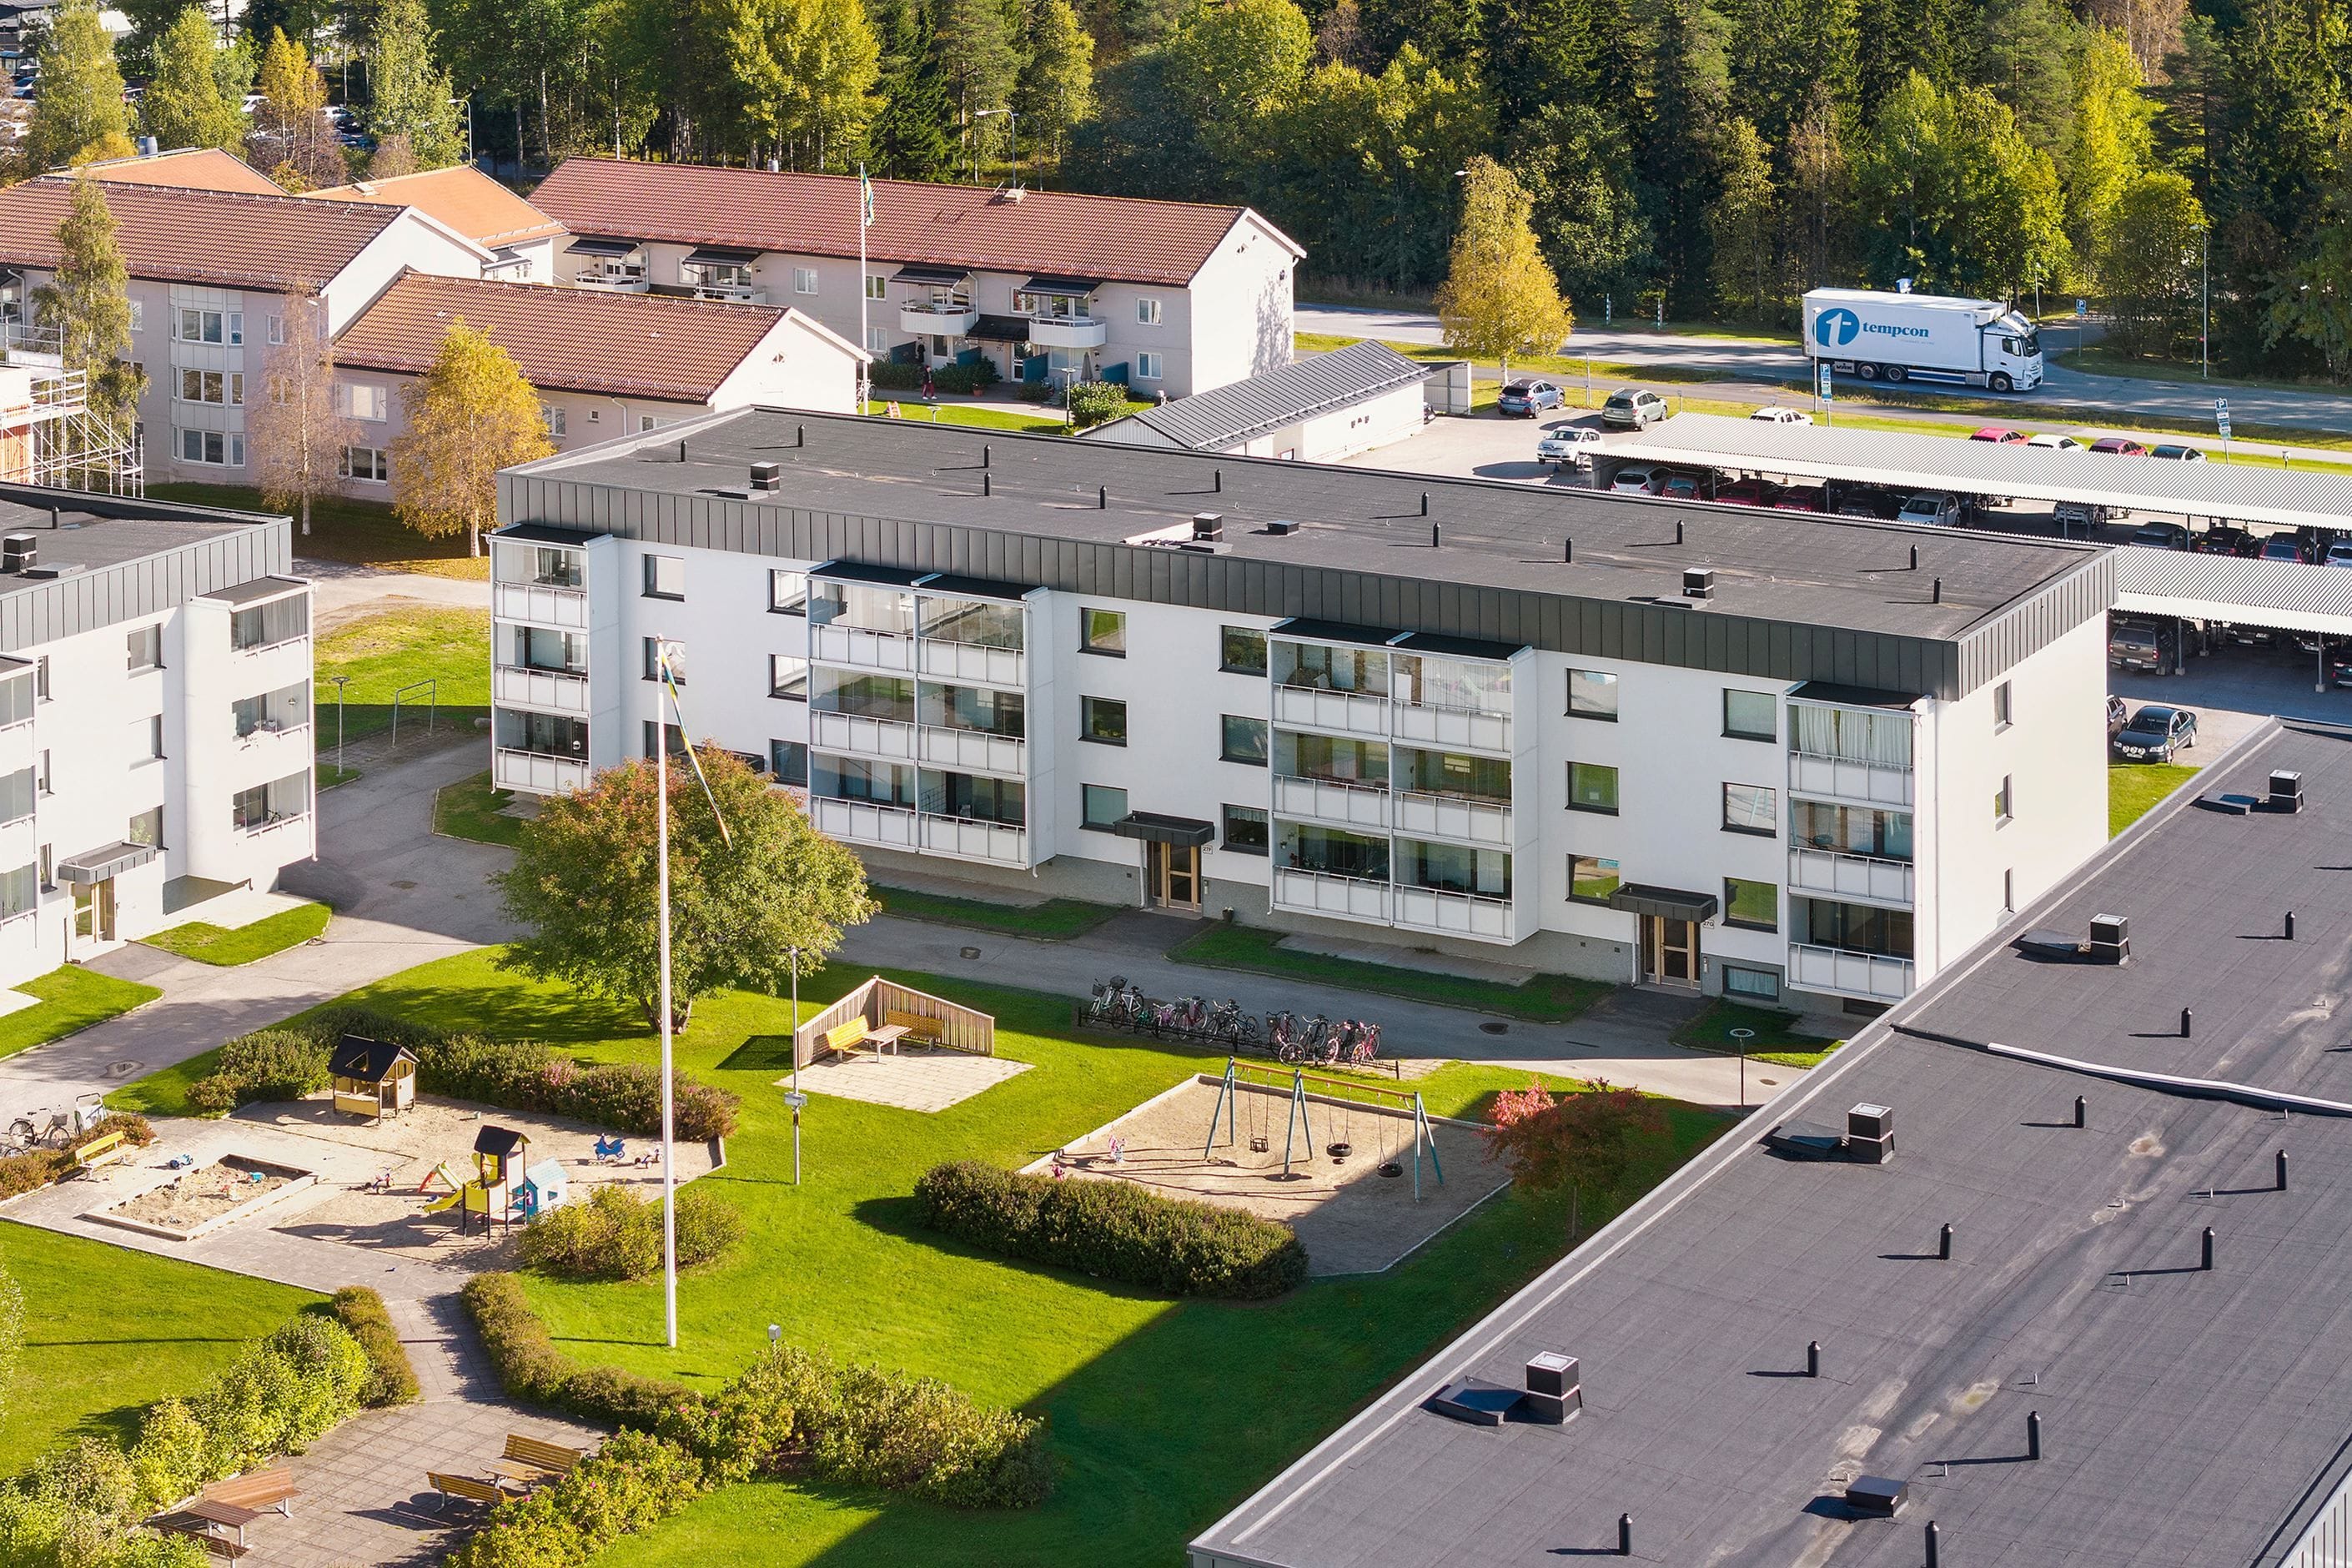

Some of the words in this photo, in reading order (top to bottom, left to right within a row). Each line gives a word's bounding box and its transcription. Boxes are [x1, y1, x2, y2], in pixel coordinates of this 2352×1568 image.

[1862, 322, 1929, 338] tempcon
[1823, 364, 1828, 373] P
[2219, 400, 2225, 409] P
